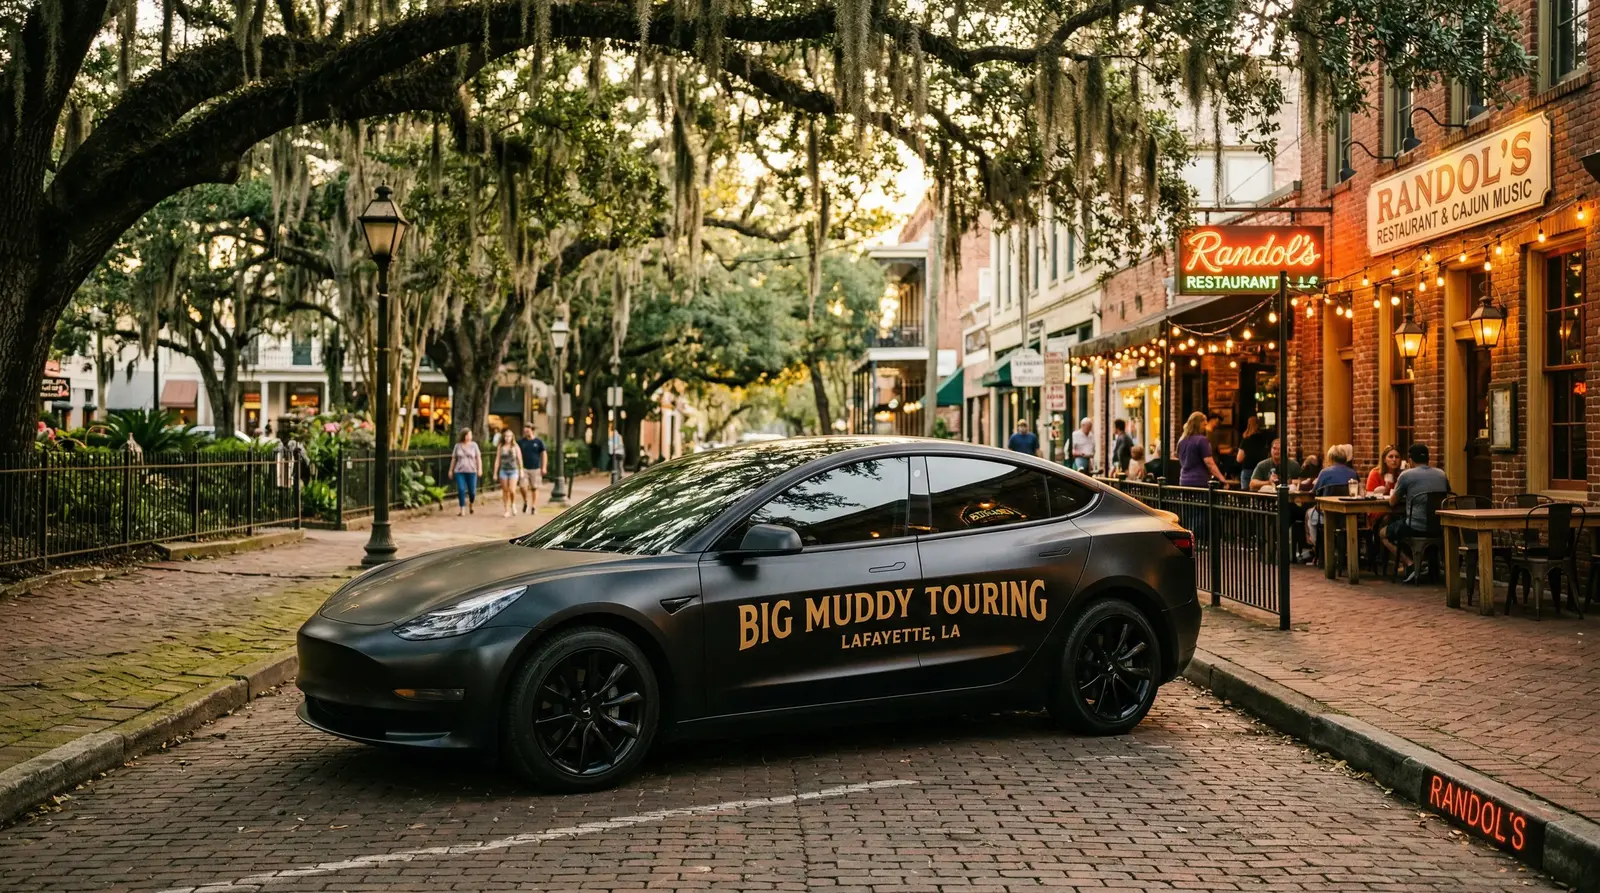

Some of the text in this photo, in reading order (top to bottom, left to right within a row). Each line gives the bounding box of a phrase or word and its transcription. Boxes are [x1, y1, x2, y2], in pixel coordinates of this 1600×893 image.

[1376, 131, 1533, 224] RANDOL'S
[1376, 178, 1533, 246] RESTAURANT & CAJUN MUSIC
[1186, 229, 1321, 273] Randol's
[1186, 275, 1279, 289] RESTAURANT
[738, 579, 1048, 651] BIG MUDDY TOURING
[841, 624, 961, 650] LAFAYETTE, LA
[1430, 775, 1526, 850] RANDOL'S
